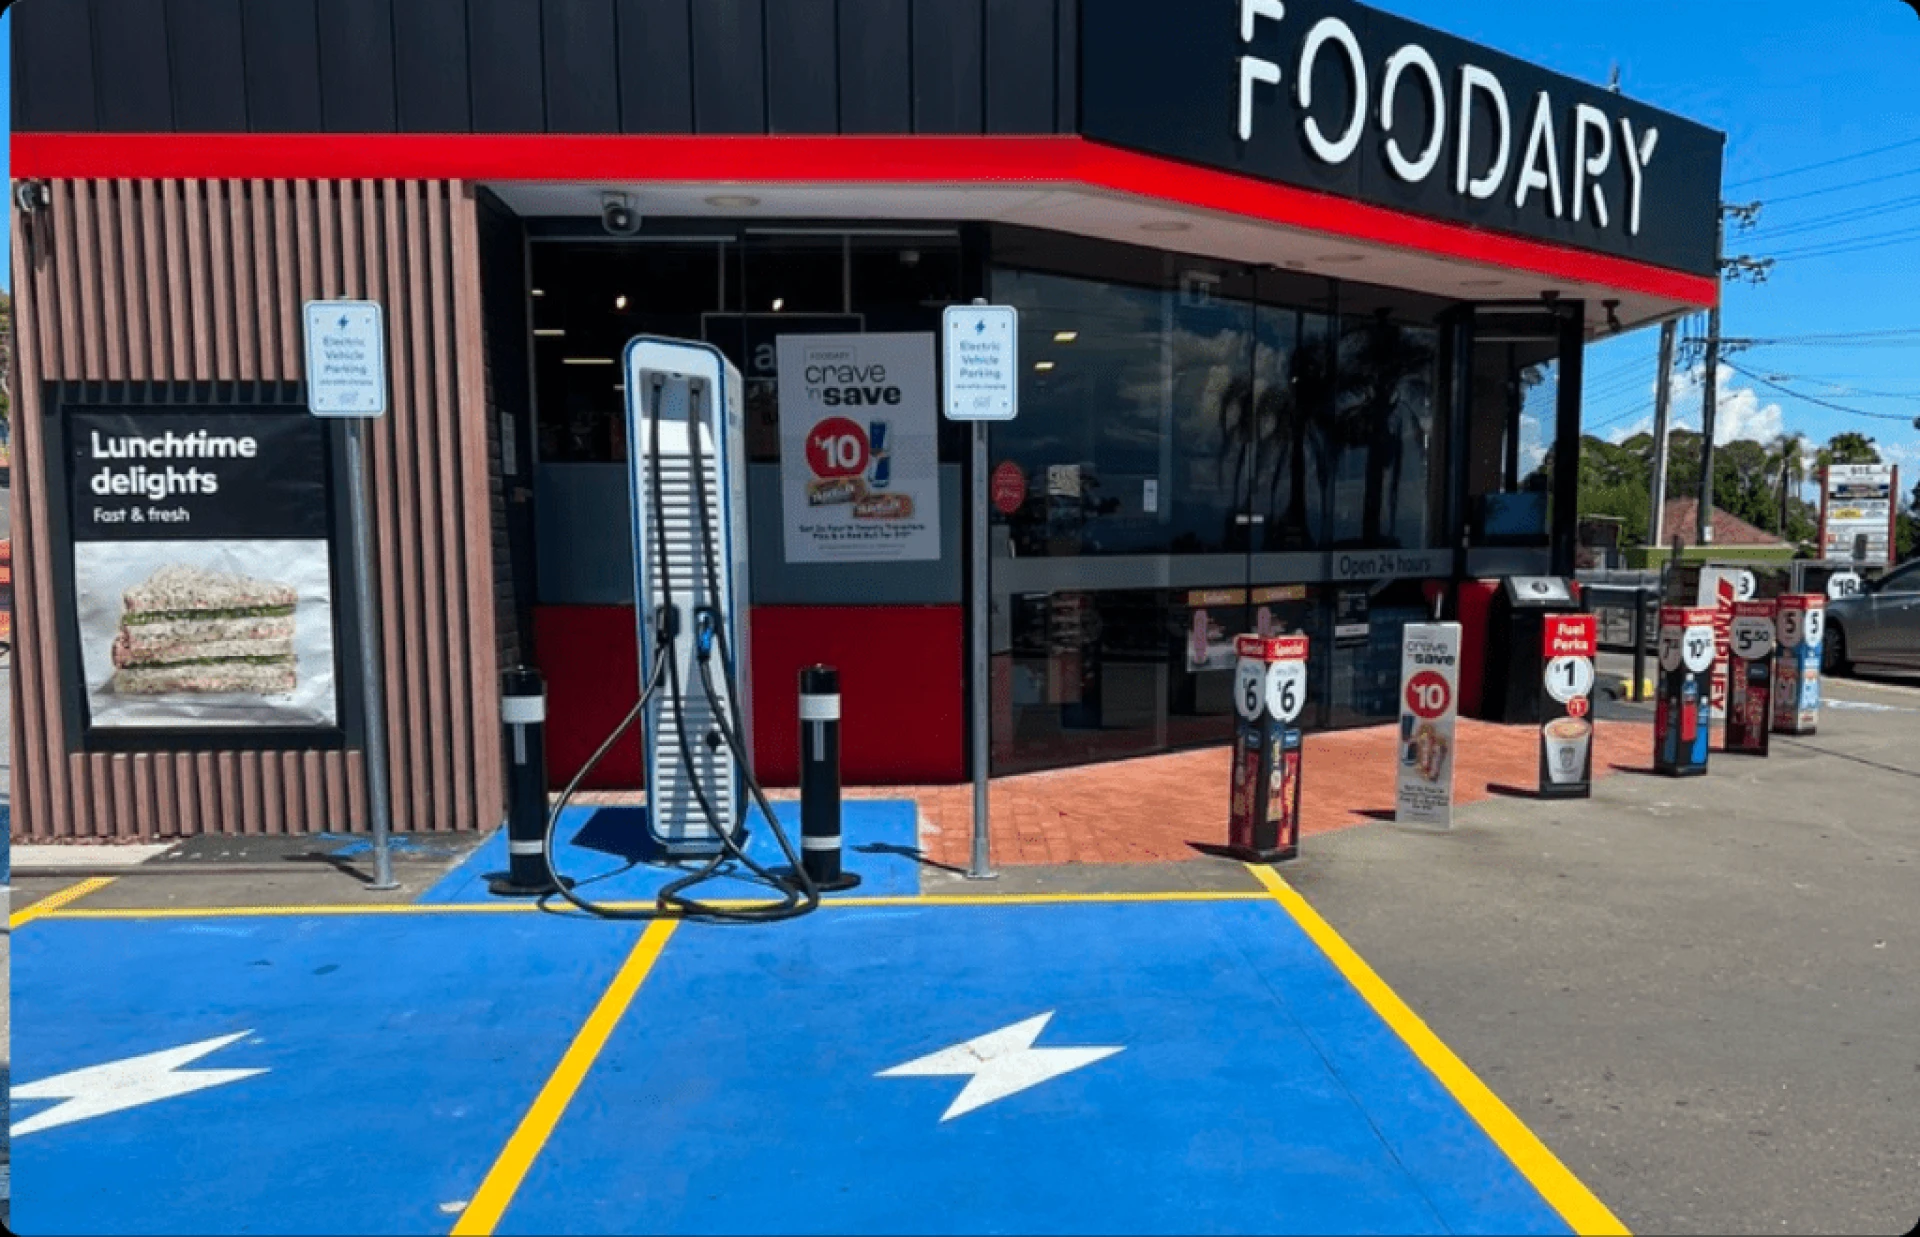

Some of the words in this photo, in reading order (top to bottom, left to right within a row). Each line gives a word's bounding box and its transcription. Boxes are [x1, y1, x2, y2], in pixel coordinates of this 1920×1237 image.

[1239, 0, 1659, 235] FOODARY
[959, 342, 1000, 351] Electric
[324, 350, 364, 360] Vehicle
[961, 355, 999, 365] Vehicle
[324, 364, 367, 376] Parking
[805, 364, 886, 384] crave
[959, 367, 1001, 379] Parking
[823, 386, 901, 406] save
[91, 429, 257, 458] Lunchtime
[91, 466, 218, 500] delights
[93, 507, 126, 523] Fast
[131, 507, 145, 523] &
[148, 506, 190, 523] fresh
[1340, 556, 1376, 579] Open
[1379, 555, 1395, 574] 24
[1397, 555, 1432, 574] hours
[1557, 623, 1585, 636] Fuel
[1553, 638, 1588, 651] Perks
